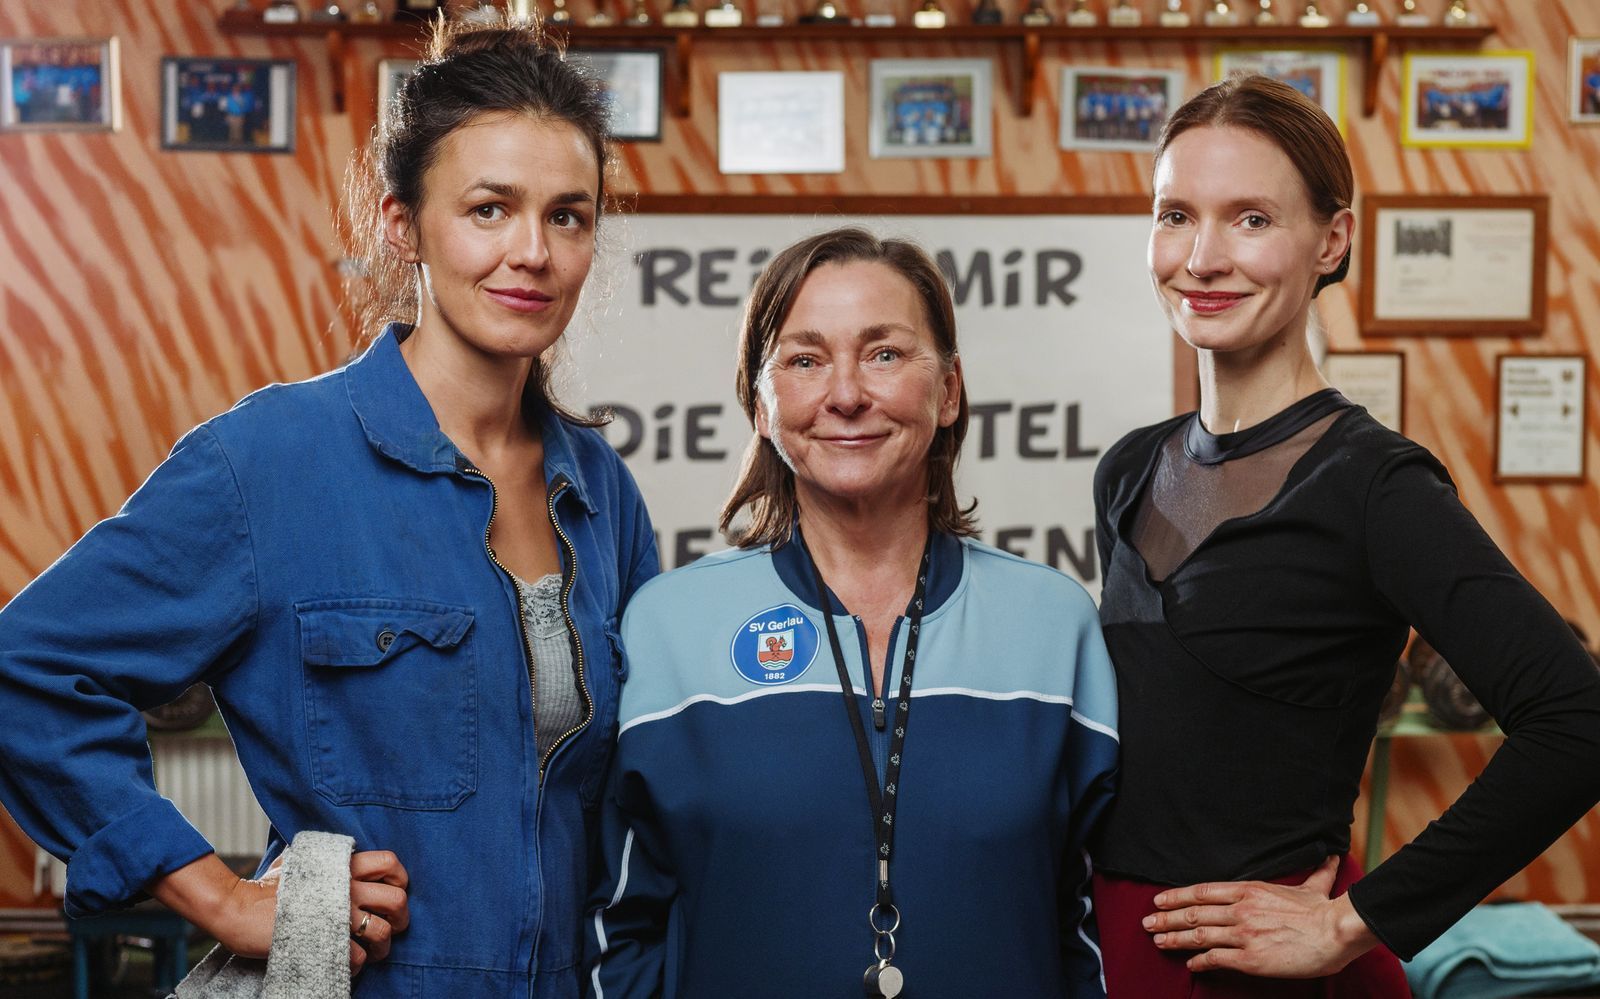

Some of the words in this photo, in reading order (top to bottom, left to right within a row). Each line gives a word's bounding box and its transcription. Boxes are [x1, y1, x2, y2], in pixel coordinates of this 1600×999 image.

[749, 622, 765, 632] SV
[768, 617, 803, 630] Gerlau
[764, 672, 785, 680] 1882
